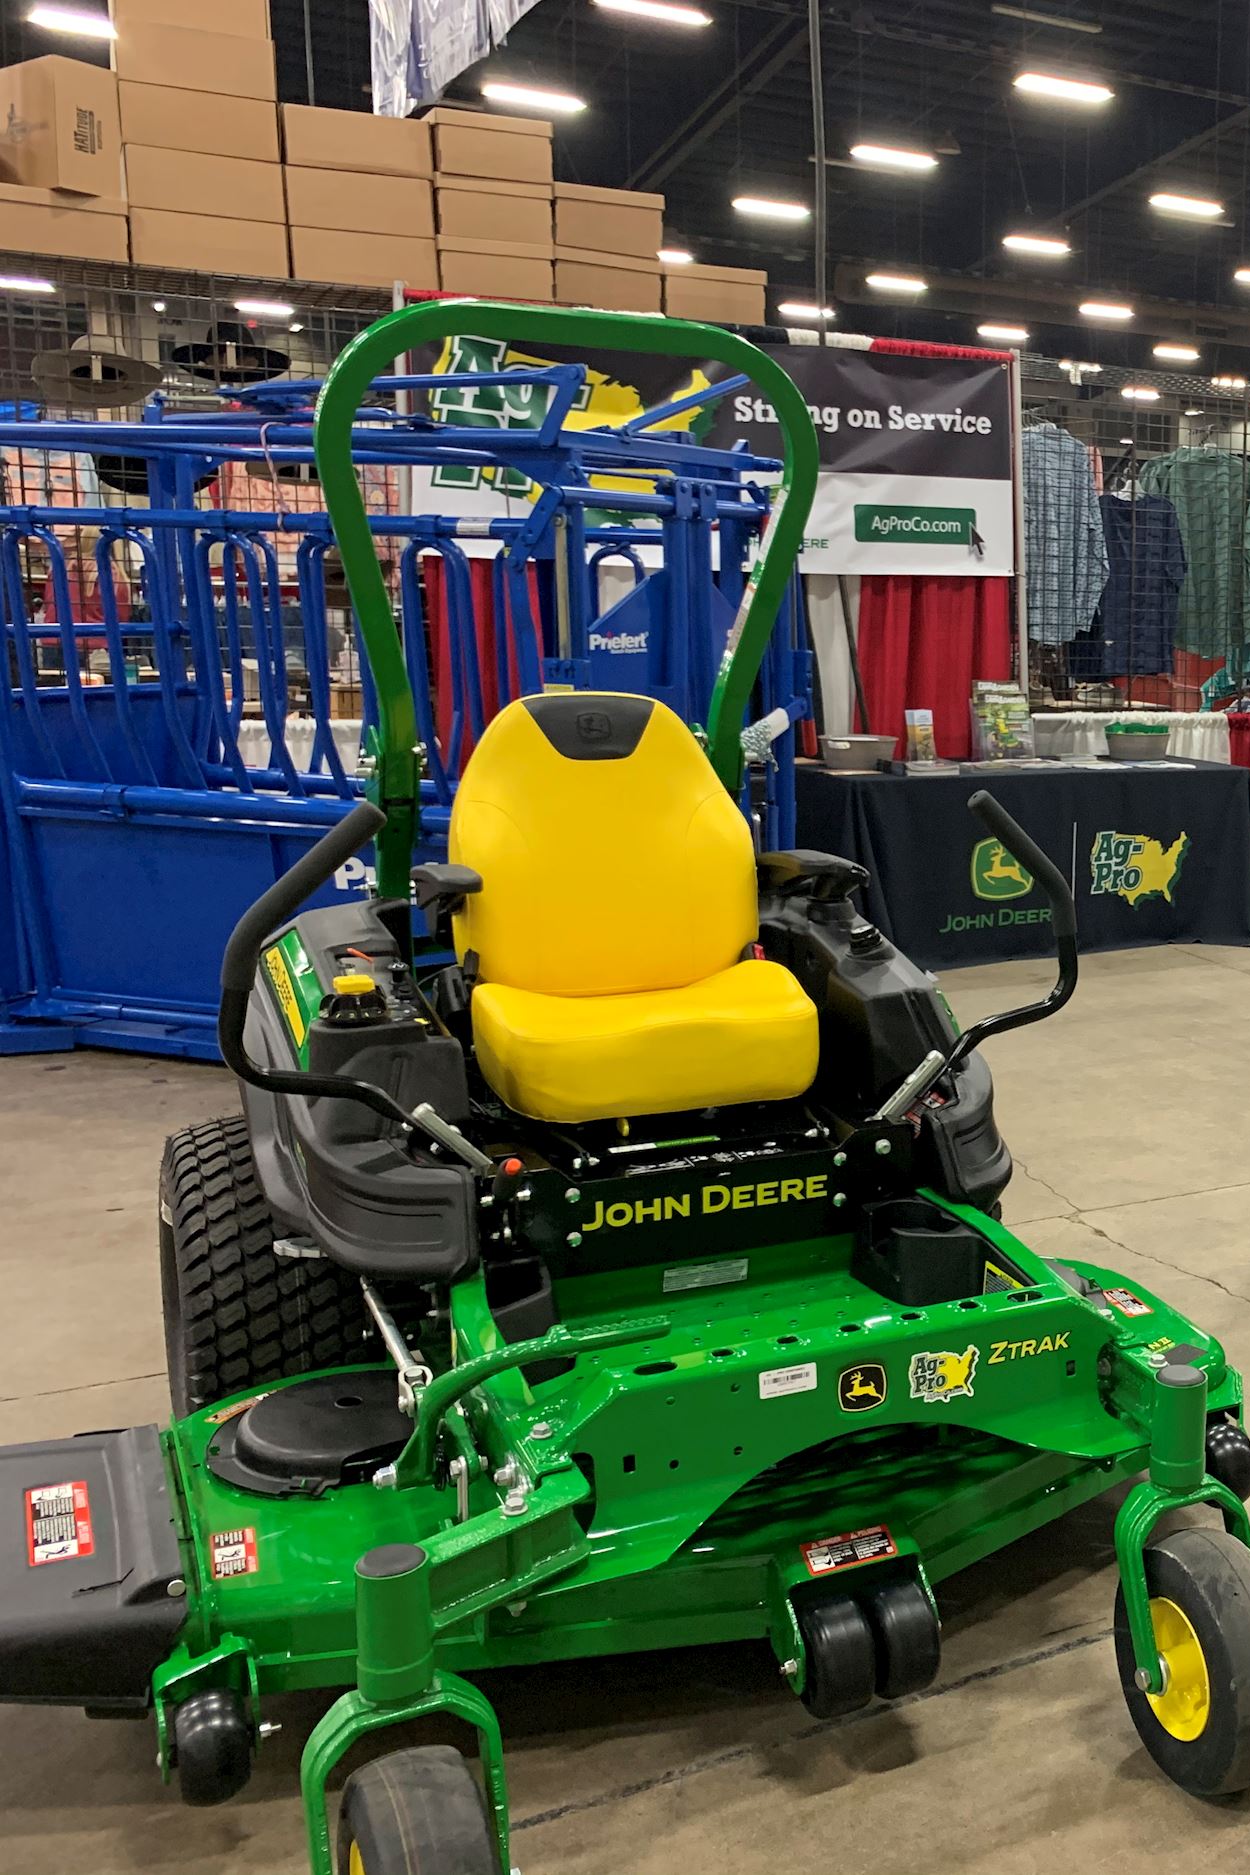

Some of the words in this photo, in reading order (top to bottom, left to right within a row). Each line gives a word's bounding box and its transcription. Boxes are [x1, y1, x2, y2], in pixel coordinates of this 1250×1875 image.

[734, 396, 840, 433] Strng
[847, 408, 882, 429] on
[889, 405, 992, 434] Service
[871, 516, 961, 535] AgProCo.com
[589, 632, 648, 651] Priefert
[1093, 830, 1145, 867] Ag-
[1090, 862, 1142, 894] Pro
[939, 914, 994, 933] JOHN
[998, 908, 1051, 928] DEER
[582, 1193, 690, 1232] JOHN
[702, 1174, 828, 1214] DEERE
[987, 1332, 1071, 1365] ZTRAK
[913, 1356, 945, 1377] Ag-
[914, 1374, 946, 1394] Pro
